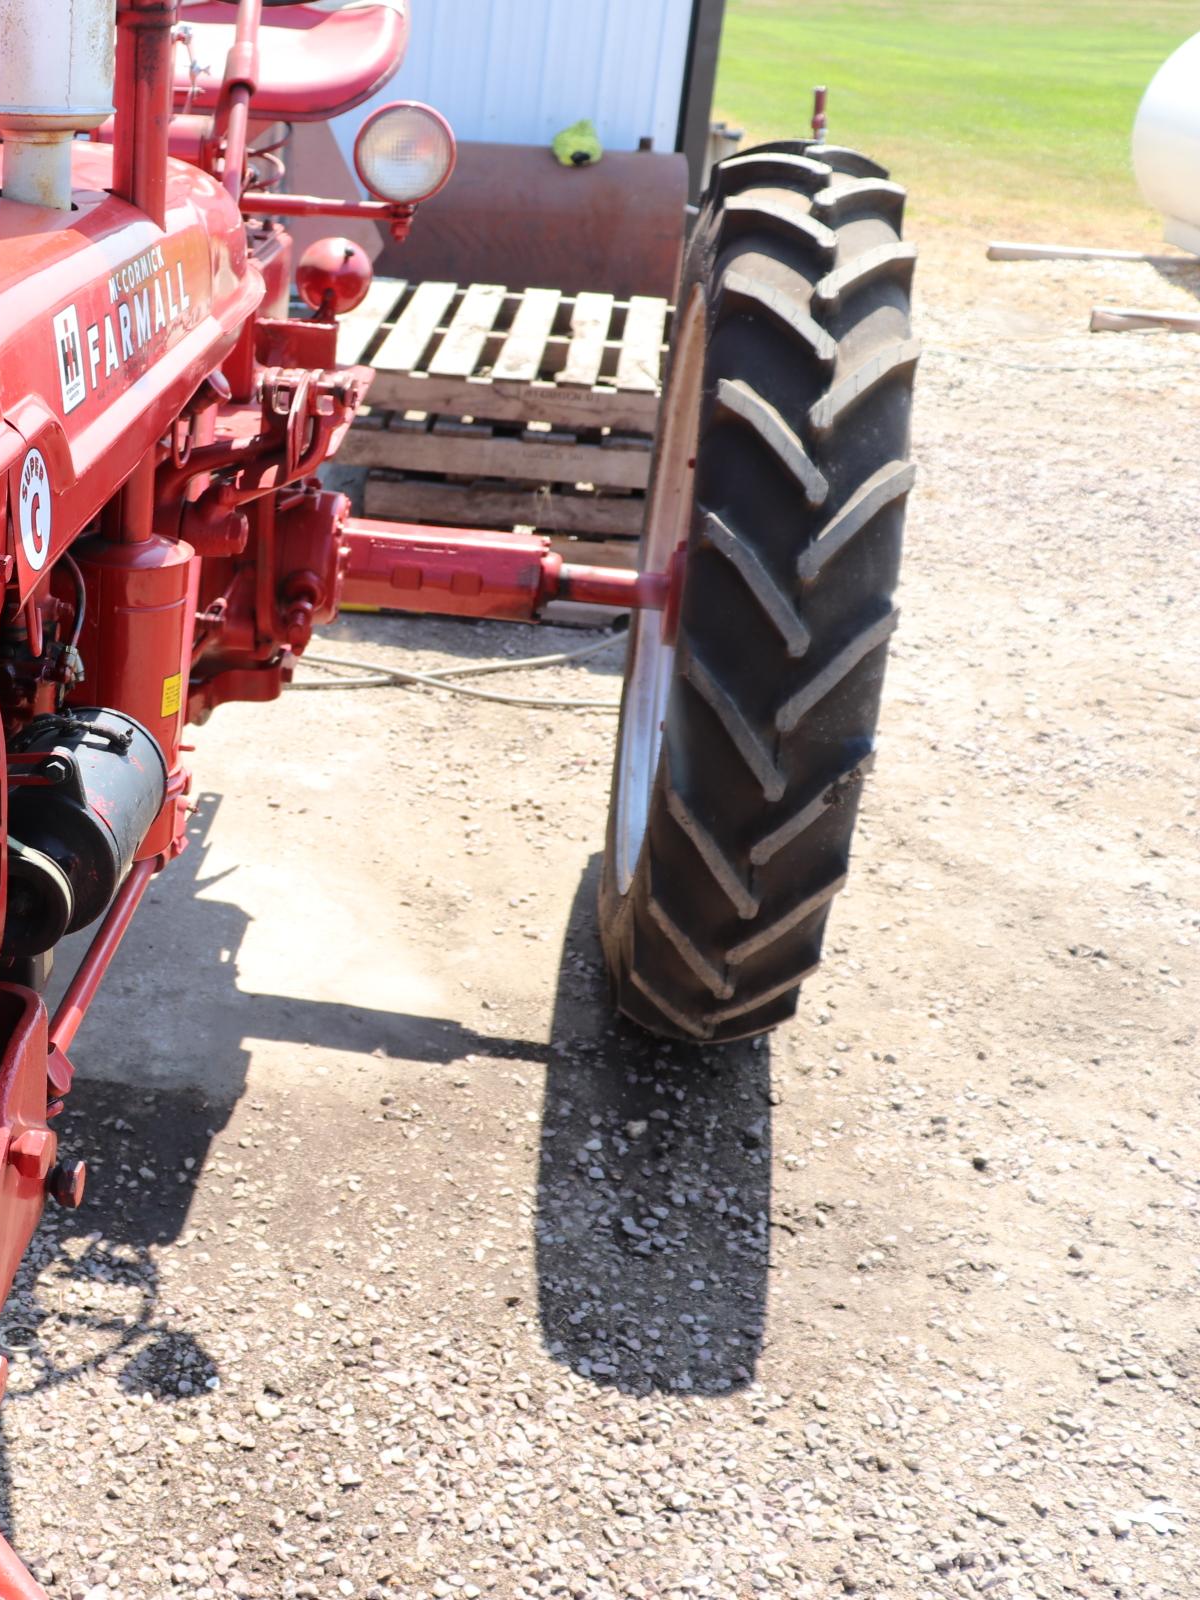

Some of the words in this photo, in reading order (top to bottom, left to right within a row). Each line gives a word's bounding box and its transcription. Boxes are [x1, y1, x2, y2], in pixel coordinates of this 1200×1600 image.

[87, 262, 190, 390] FARMALL
[22, 456, 44, 503] SUPER
[31, 492, 43, 554] C
